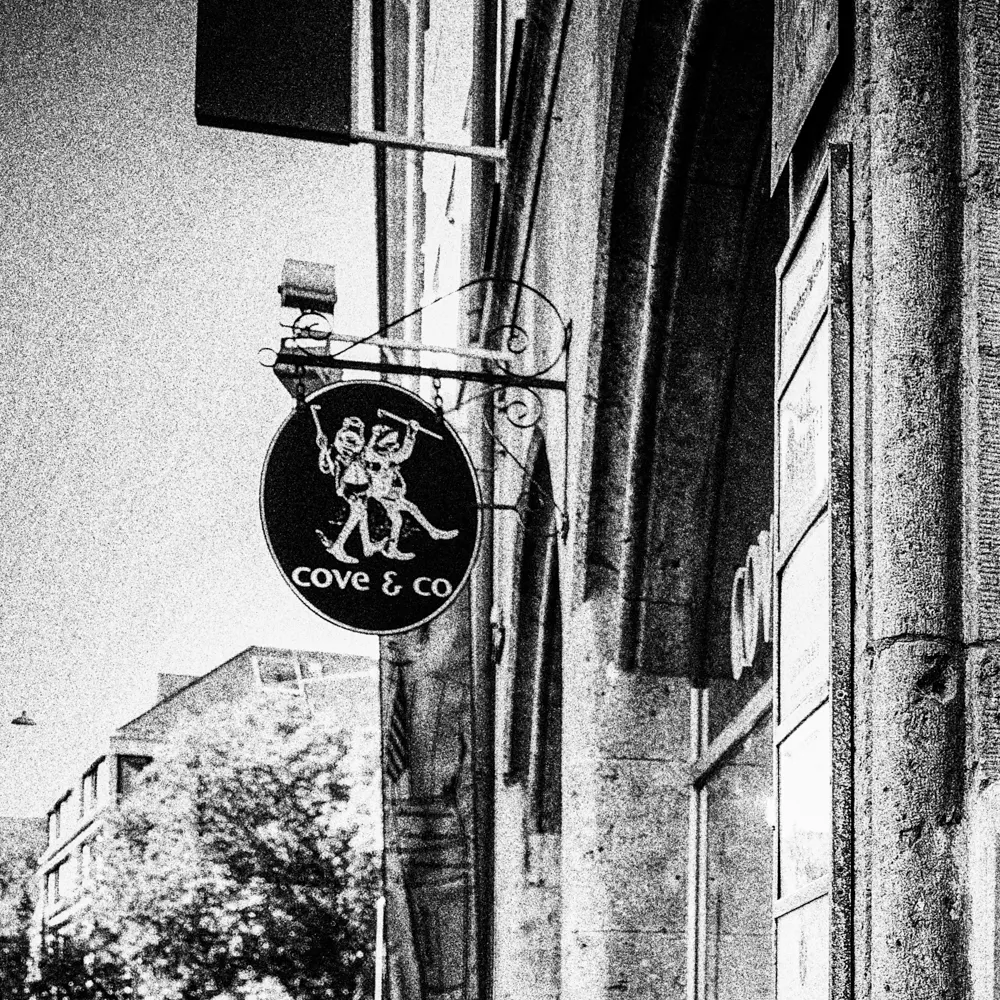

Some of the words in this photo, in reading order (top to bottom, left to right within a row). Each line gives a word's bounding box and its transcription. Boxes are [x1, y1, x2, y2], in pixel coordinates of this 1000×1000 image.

[291, 566, 370, 591] cove
[381, 570, 403, 597] &
[412, 576, 453, 598] co
